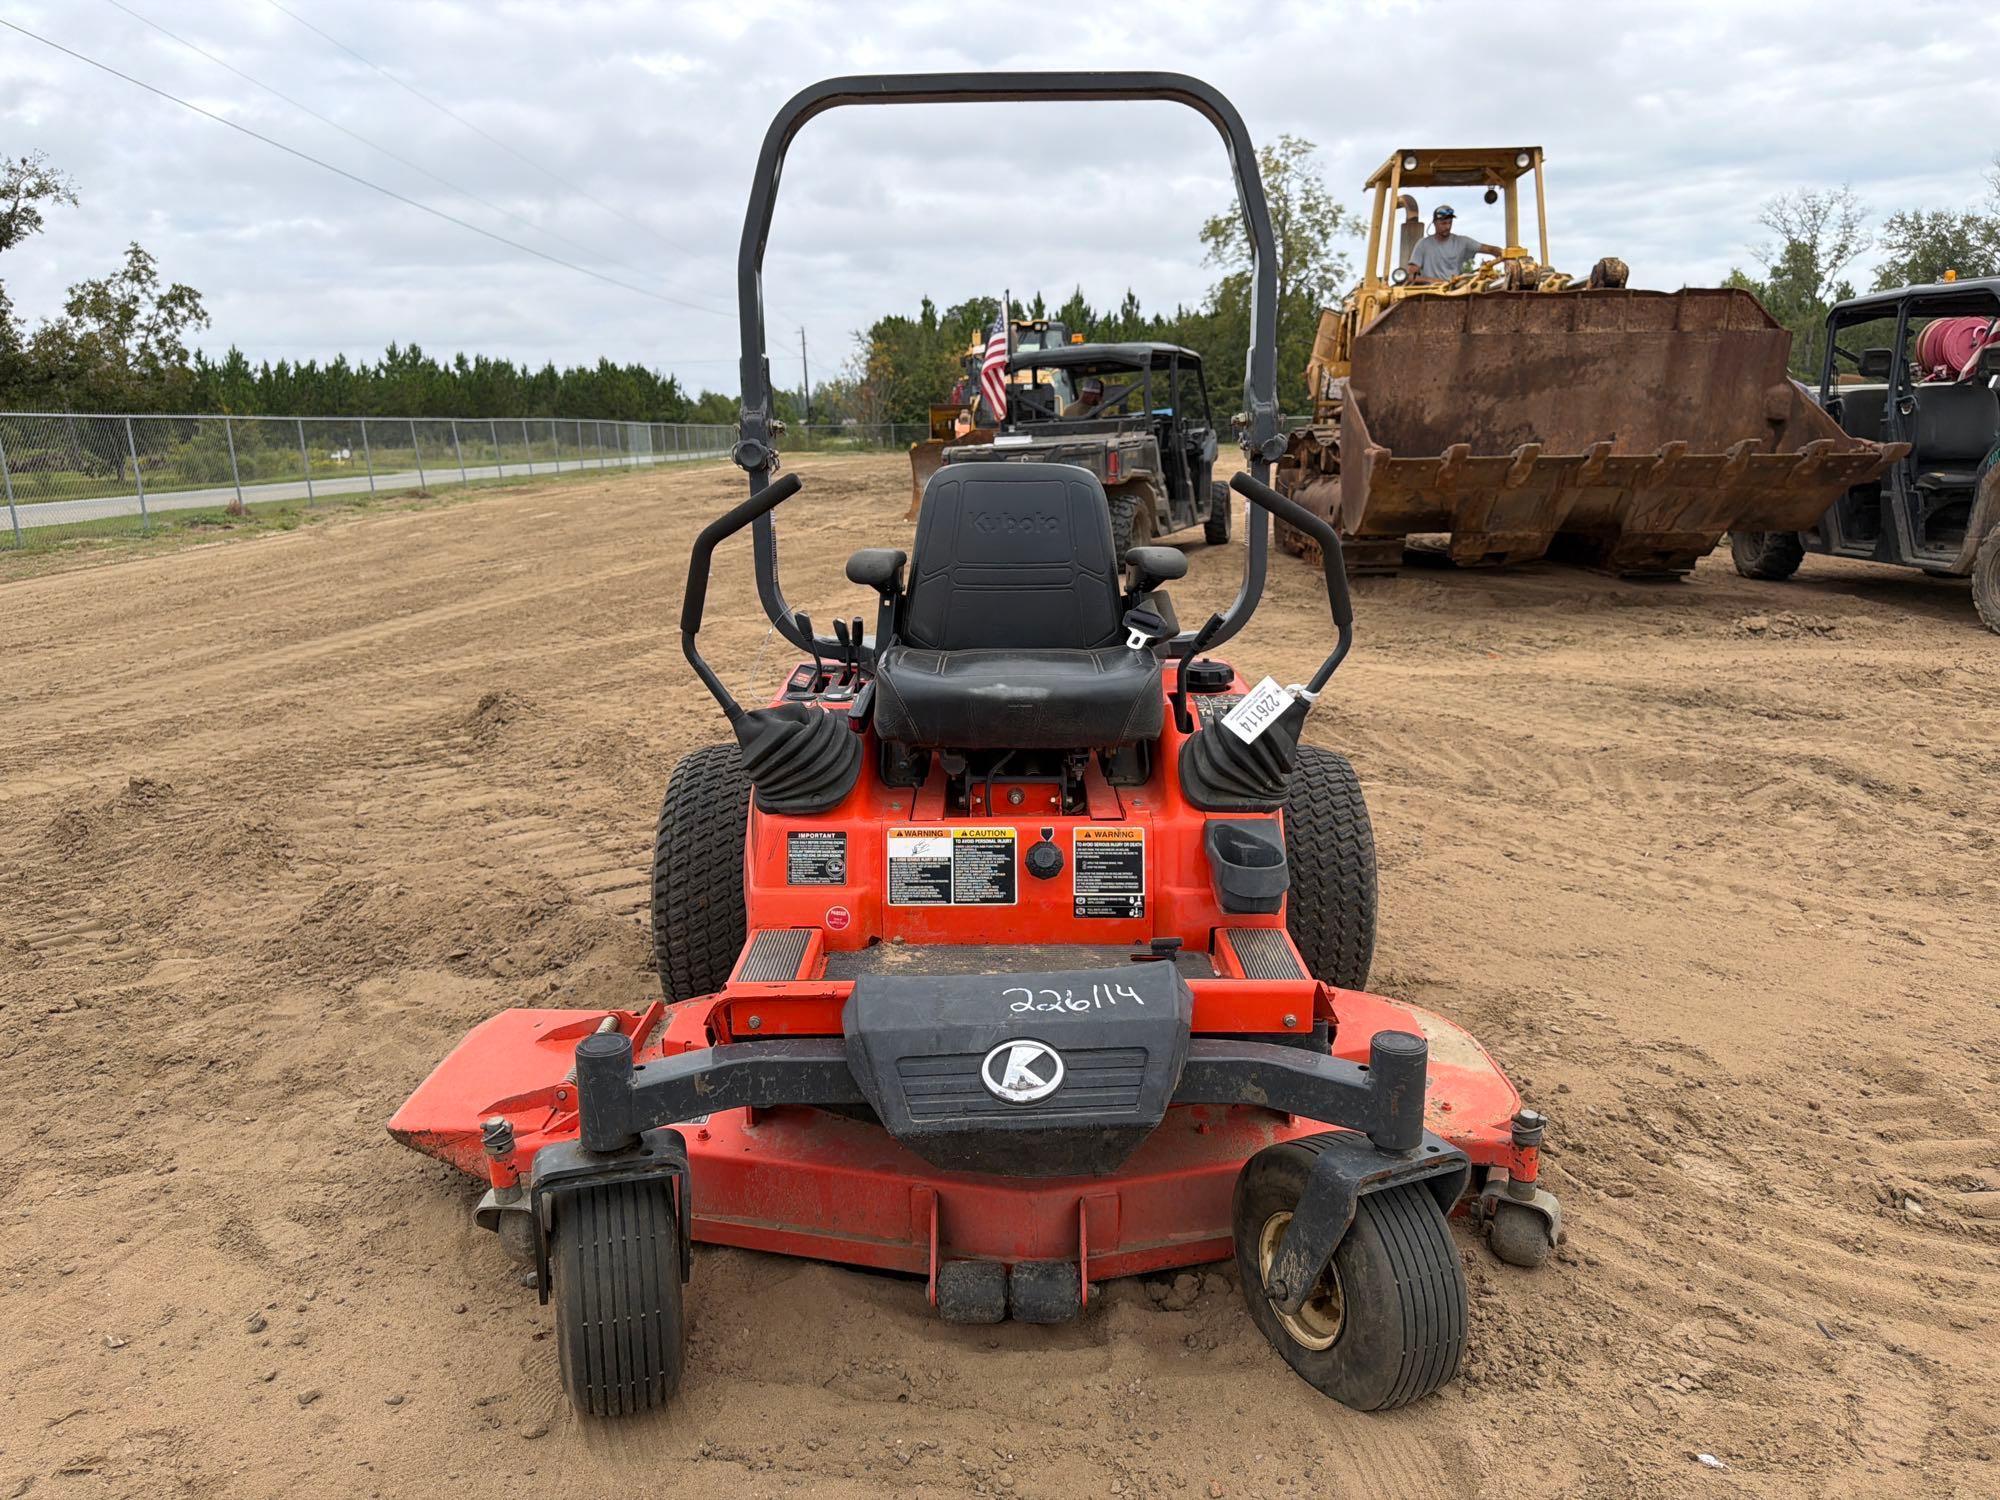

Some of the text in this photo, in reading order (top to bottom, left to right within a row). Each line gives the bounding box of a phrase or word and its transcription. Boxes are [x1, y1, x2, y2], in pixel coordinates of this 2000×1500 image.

[967, 510, 1061, 535] Kubota
[1239, 694, 1280, 733] 226114
[968, 829, 1007, 837] CAUTION
[1094, 831, 1135, 839] WARNING
[1002, 983, 1145, 1013] 226114
